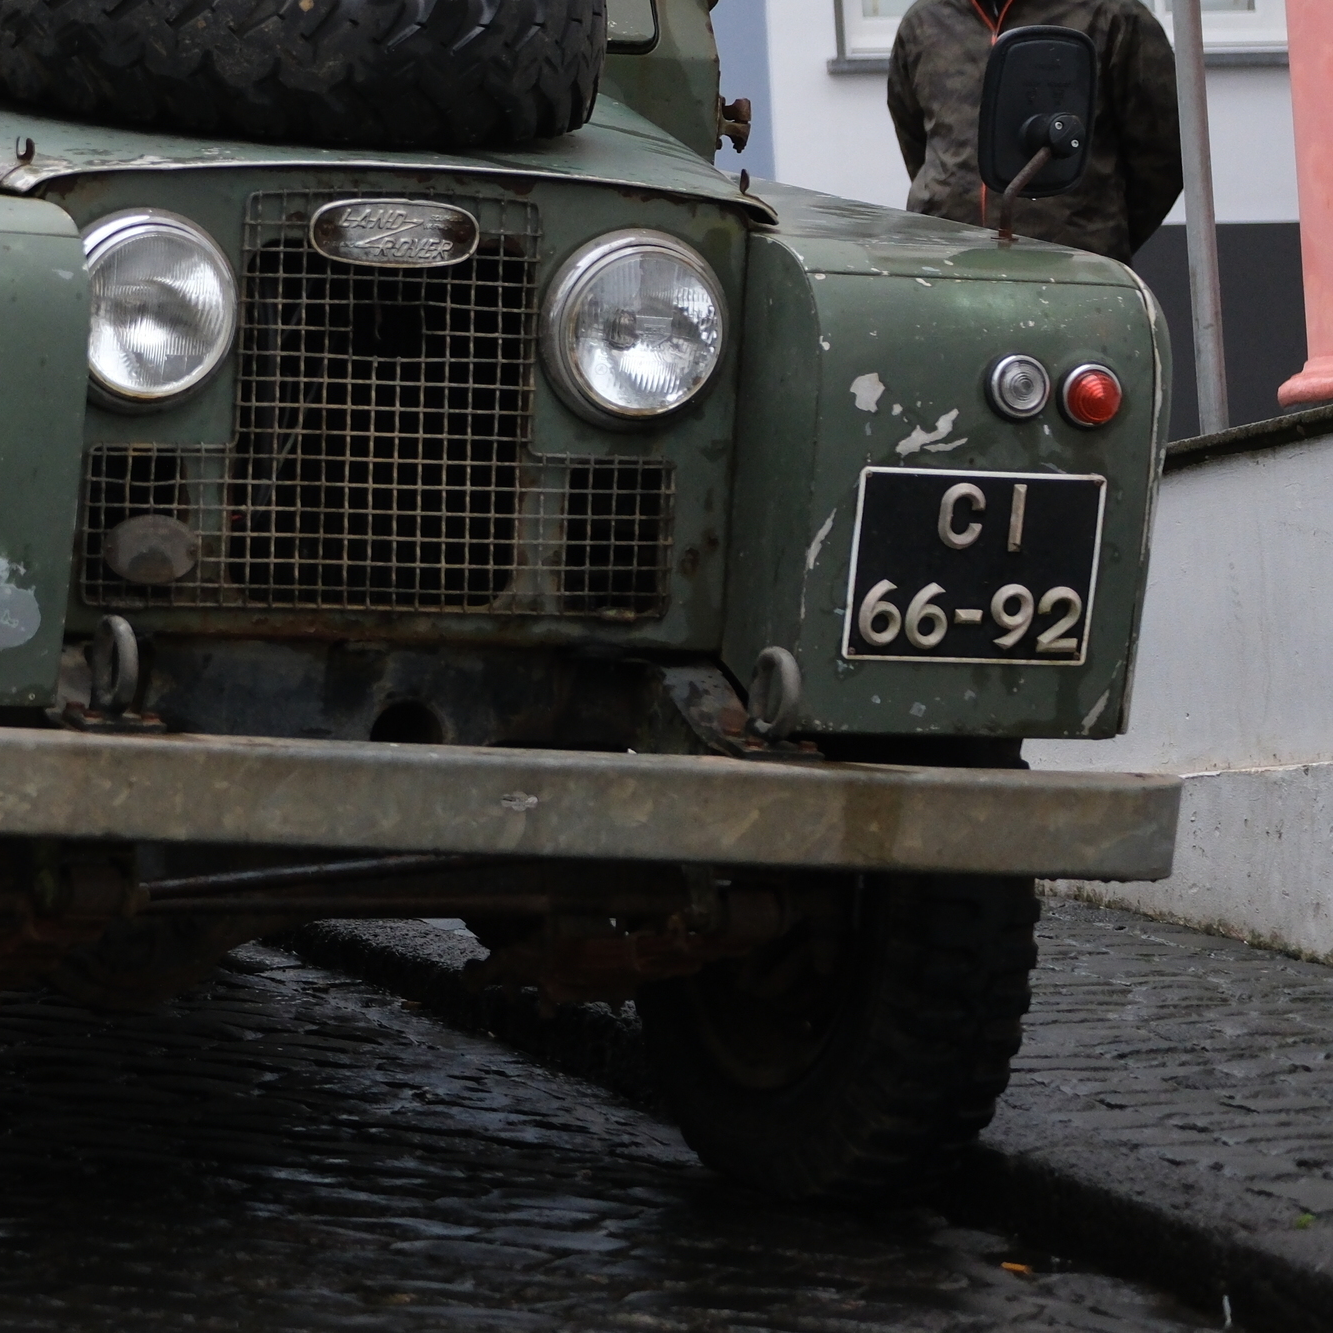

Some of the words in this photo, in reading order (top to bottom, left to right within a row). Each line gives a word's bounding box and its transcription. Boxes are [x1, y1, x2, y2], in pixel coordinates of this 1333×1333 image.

[339, 208, 407, 230] LAND
[374, 238, 454, 260] ROVER
[858, 579, 1082, 653] 66-92
